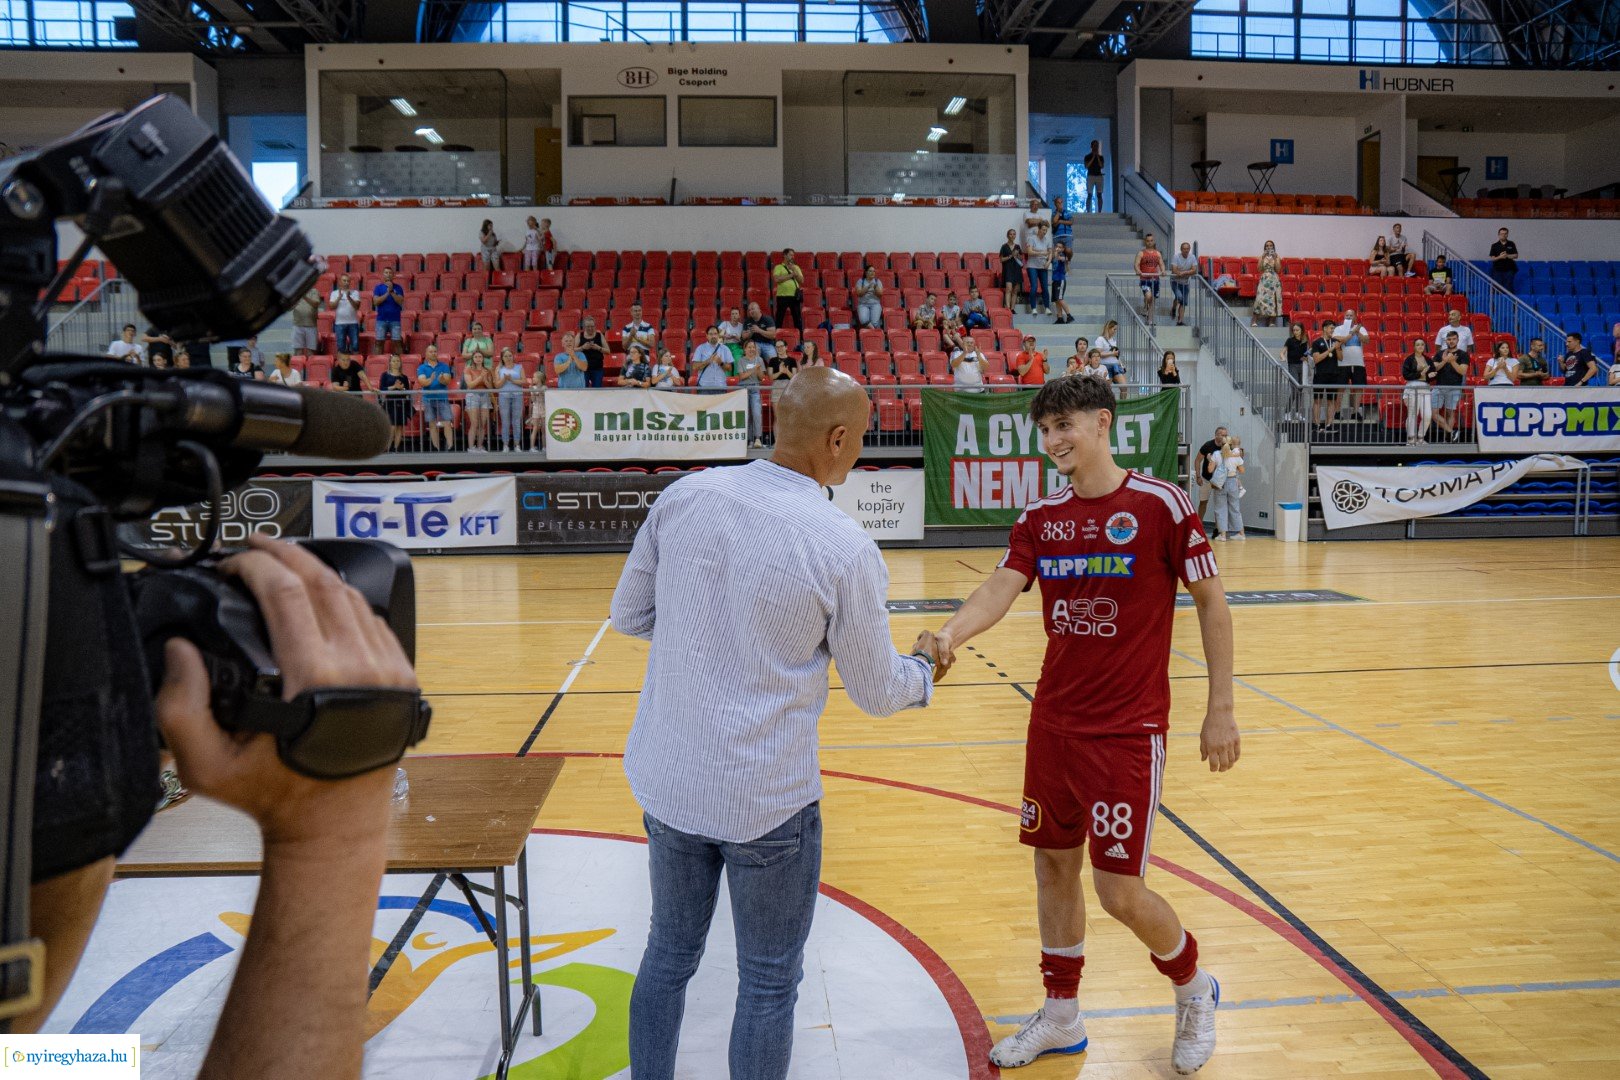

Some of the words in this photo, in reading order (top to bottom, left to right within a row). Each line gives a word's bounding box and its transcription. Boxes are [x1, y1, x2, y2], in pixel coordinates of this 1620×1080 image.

[667, 67, 689, 76] Bige
[691, 67, 728, 76] Holding
[678, 78, 717, 87] Csoport
[1382, 77, 1454, 92] HÜBNER
[594, 408, 746, 432] mlsz.hu
[594, 432, 632, 442] Magyar
[636, 432, 690, 442] Labdarúgó
[694, 431, 747, 442] Szövetség
[954, 414, 980, 456] A
[870, 481, 892, 494] the
[953, 460, 1041, 510] NEM
[325, 495, 453, 538] Ta-Te
[459, 514, 500, 536] KFT
[862, 518, 900, 529] water
[1040, 520, 1075, 541] 383
[1091, 801, 1133, 840] 88
